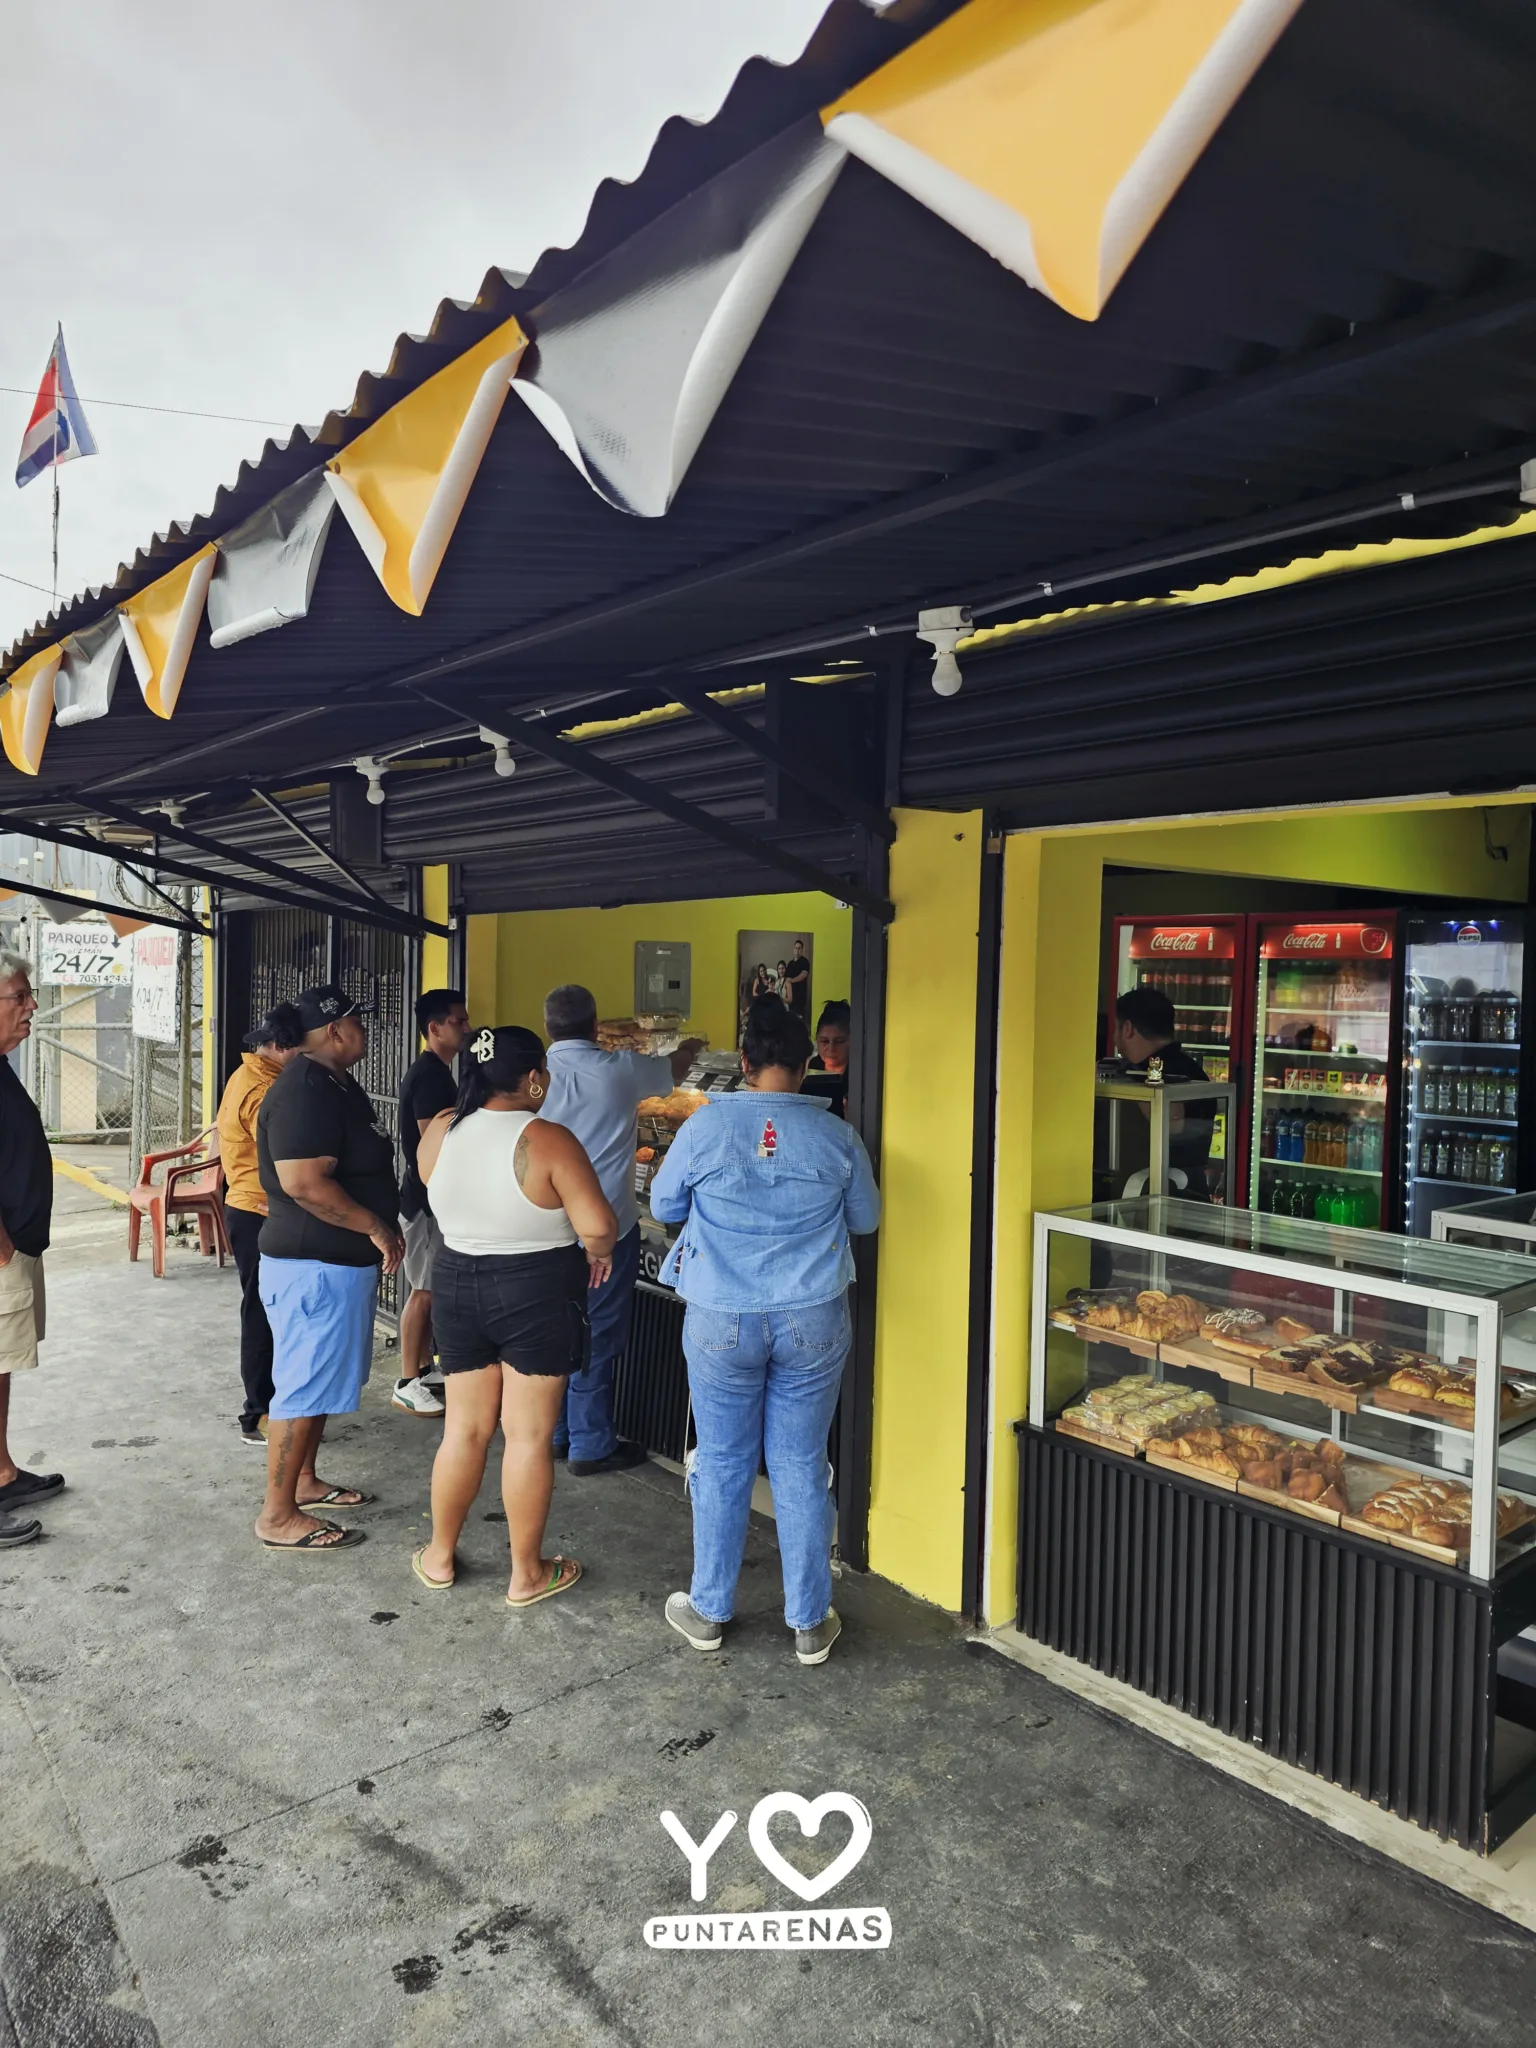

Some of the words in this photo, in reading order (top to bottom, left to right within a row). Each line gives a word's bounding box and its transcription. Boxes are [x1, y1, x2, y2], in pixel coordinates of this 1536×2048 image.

[48, 932, 108, 945] PARQUEO
[1150, 932, 1200, 951] Coca-Cola
[1282, 932, 1329, 949] Coca-Cola
[52, 952, 115, 973] 24/7
[79, 974, 101, 983] 7031
